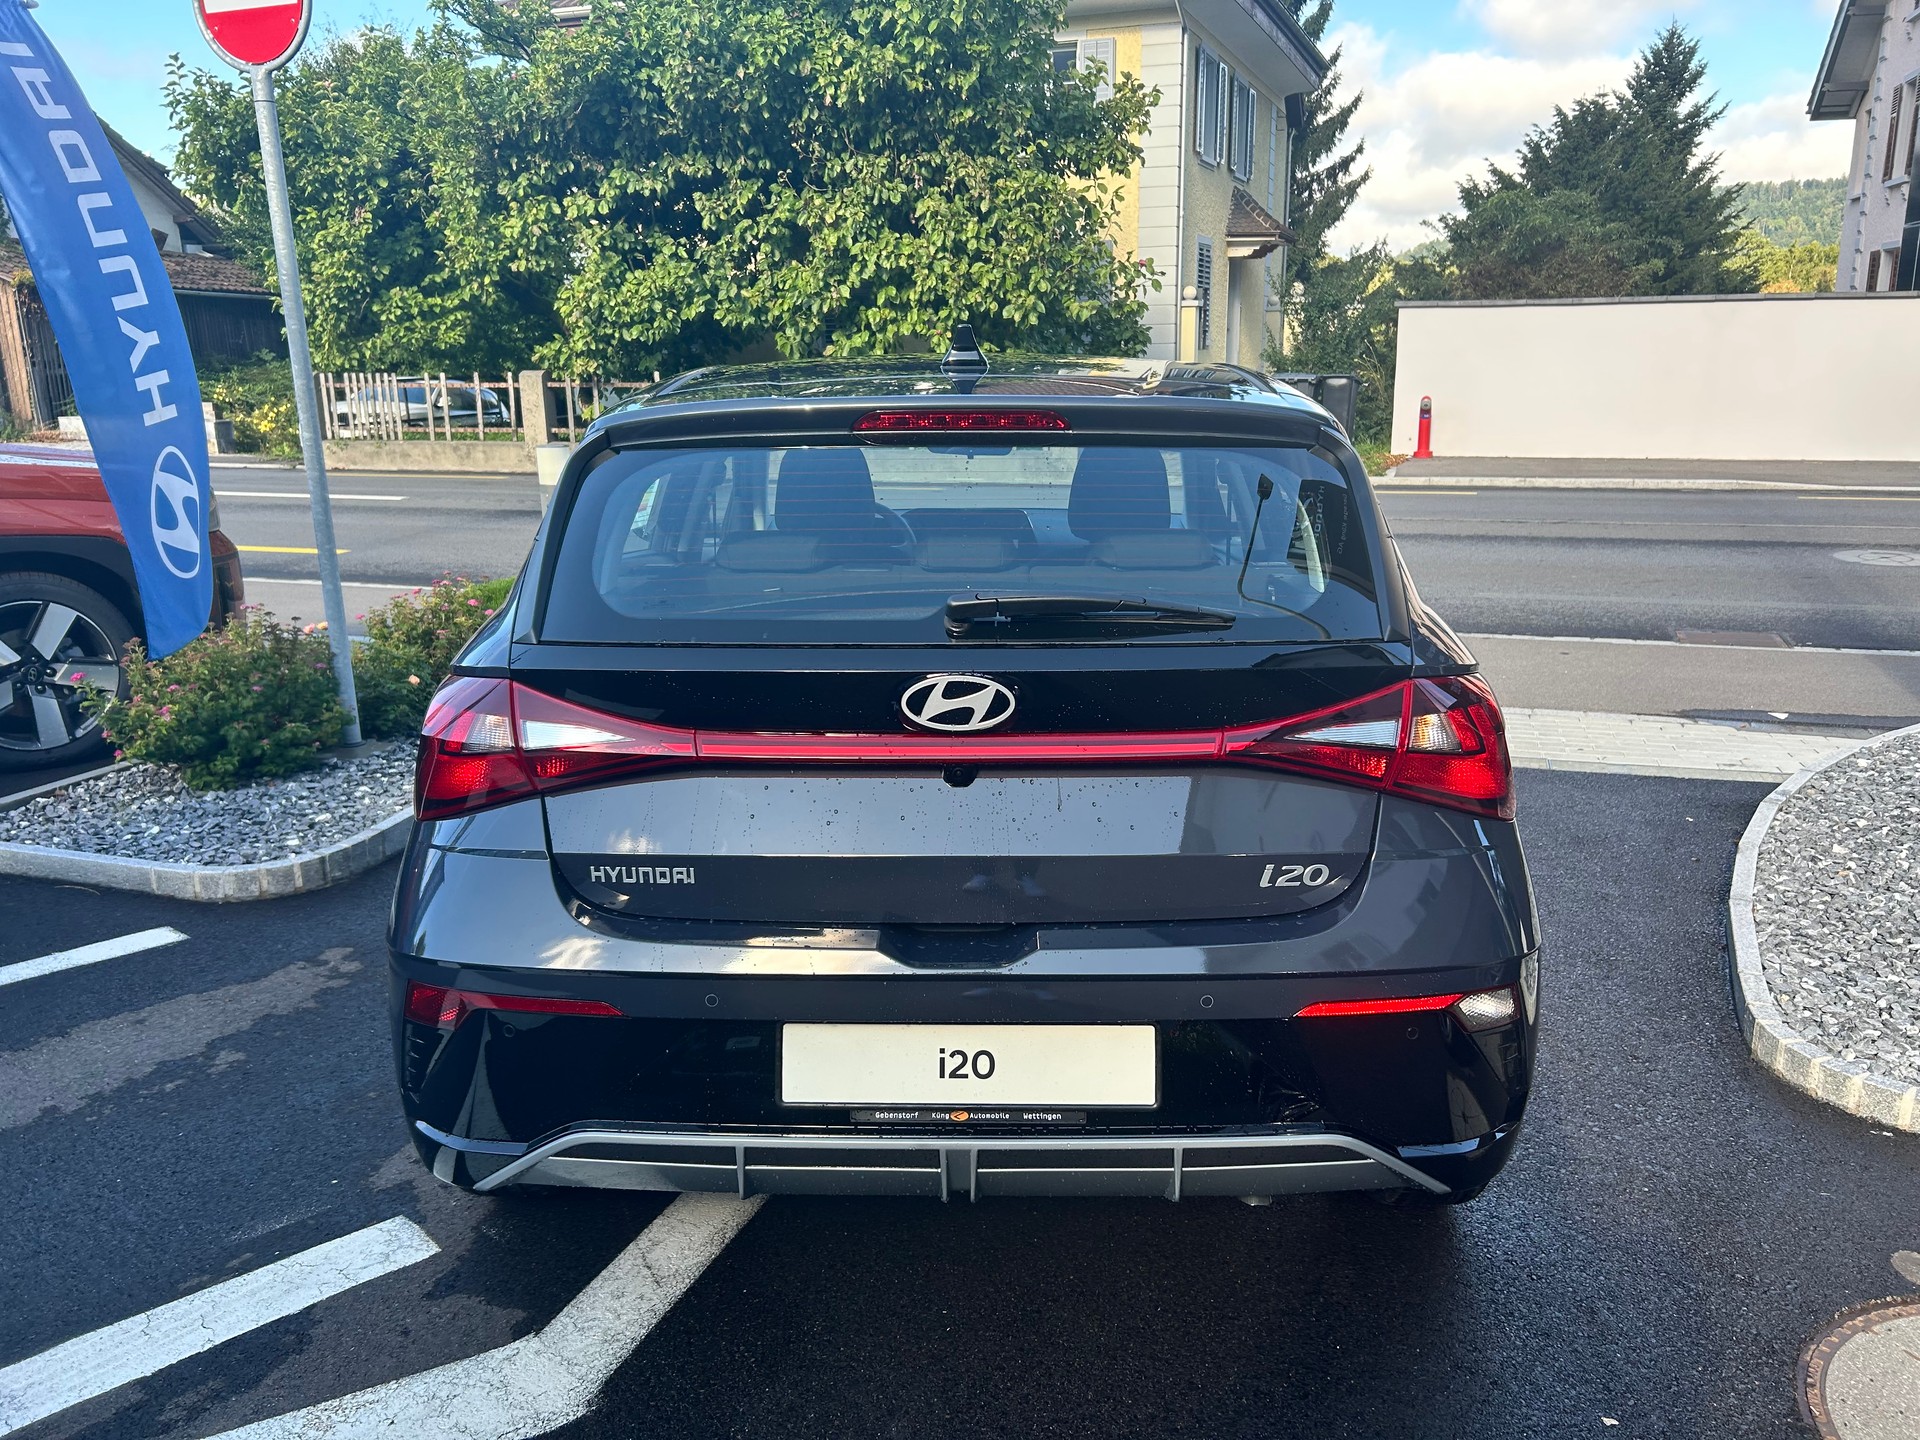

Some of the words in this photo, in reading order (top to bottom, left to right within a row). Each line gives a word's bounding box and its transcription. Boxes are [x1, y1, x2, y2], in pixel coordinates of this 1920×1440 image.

[0, 42, 178, 427] HYUNDAI
[590, 866, 695, 884] HYUNDAI
[1259, 864, 1330, 888] i20
[939, 1048, 995, 1079] i20
[875, 1111, 919, 1119] Gebenstorf
[931, 1112, 950, 1120] Küng
[1023, 1112, 1062, 1120] Wettingen
